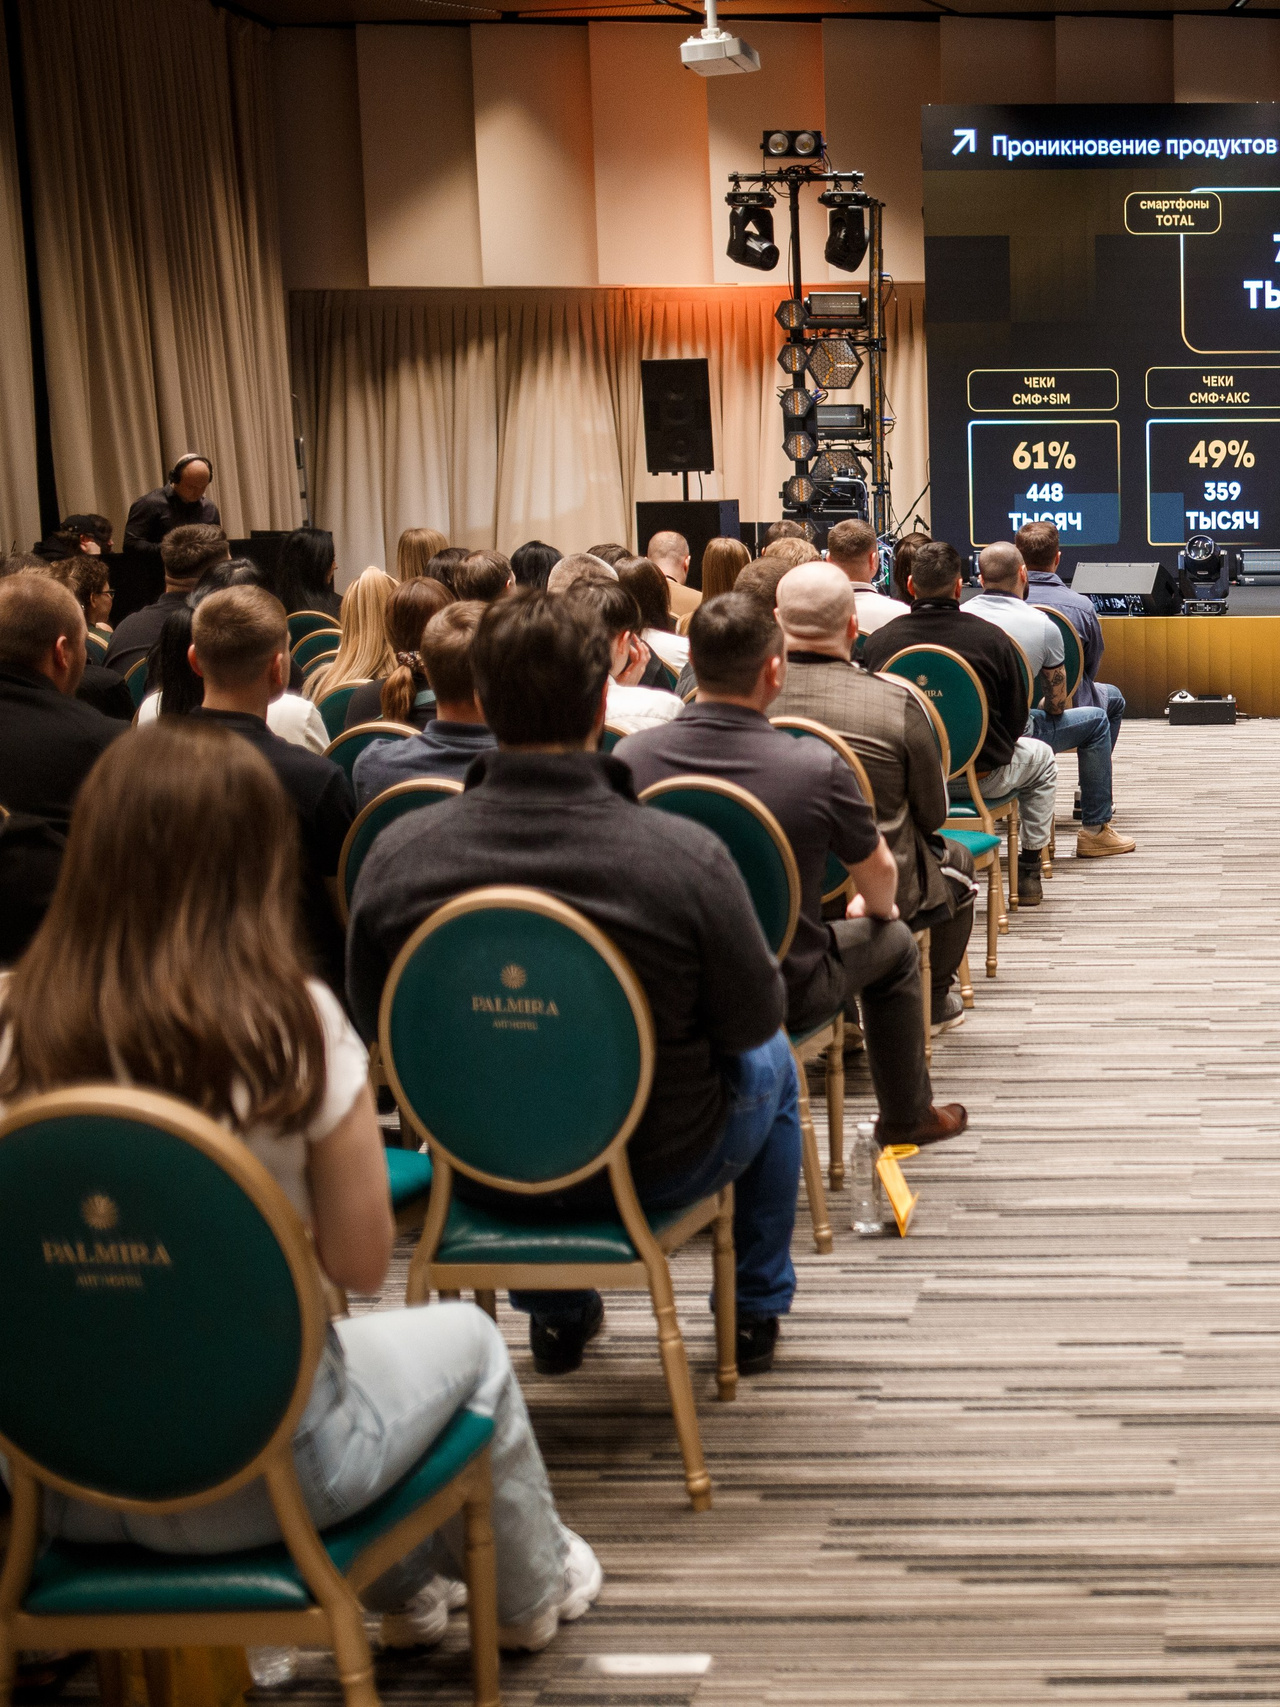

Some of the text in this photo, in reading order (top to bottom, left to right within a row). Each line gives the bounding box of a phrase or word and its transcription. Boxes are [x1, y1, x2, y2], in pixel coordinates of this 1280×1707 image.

[992, 135, 1161, 162] Проникновение
[1166, 138, 1278, 160] продуктов
[1139, 197, 1210, 212] смартфоны
[1155, 214, 1195, 227] TOTAL
[1024, 376, 1056, 388] ЧЕКИ
[1202, 375, 1234, 387] ЧЕКИ
[1012, 393, 1071, 405] СМФ+SIM
[1189, 391, 1250, 404] СМФ+АКС
[1012, 441, 1077, 470] 61%
[1188, 439, 1255, 468] 49%
[1025, 482, 1064, 503] 448
[1203, 481, 1242, 502] 359
[1185, 510, 1259, 530] ТЫСЯЧ
[472, 996, 559, 1016] PALMIRA
[42, 1241, 173, 1267] PALMIRA
